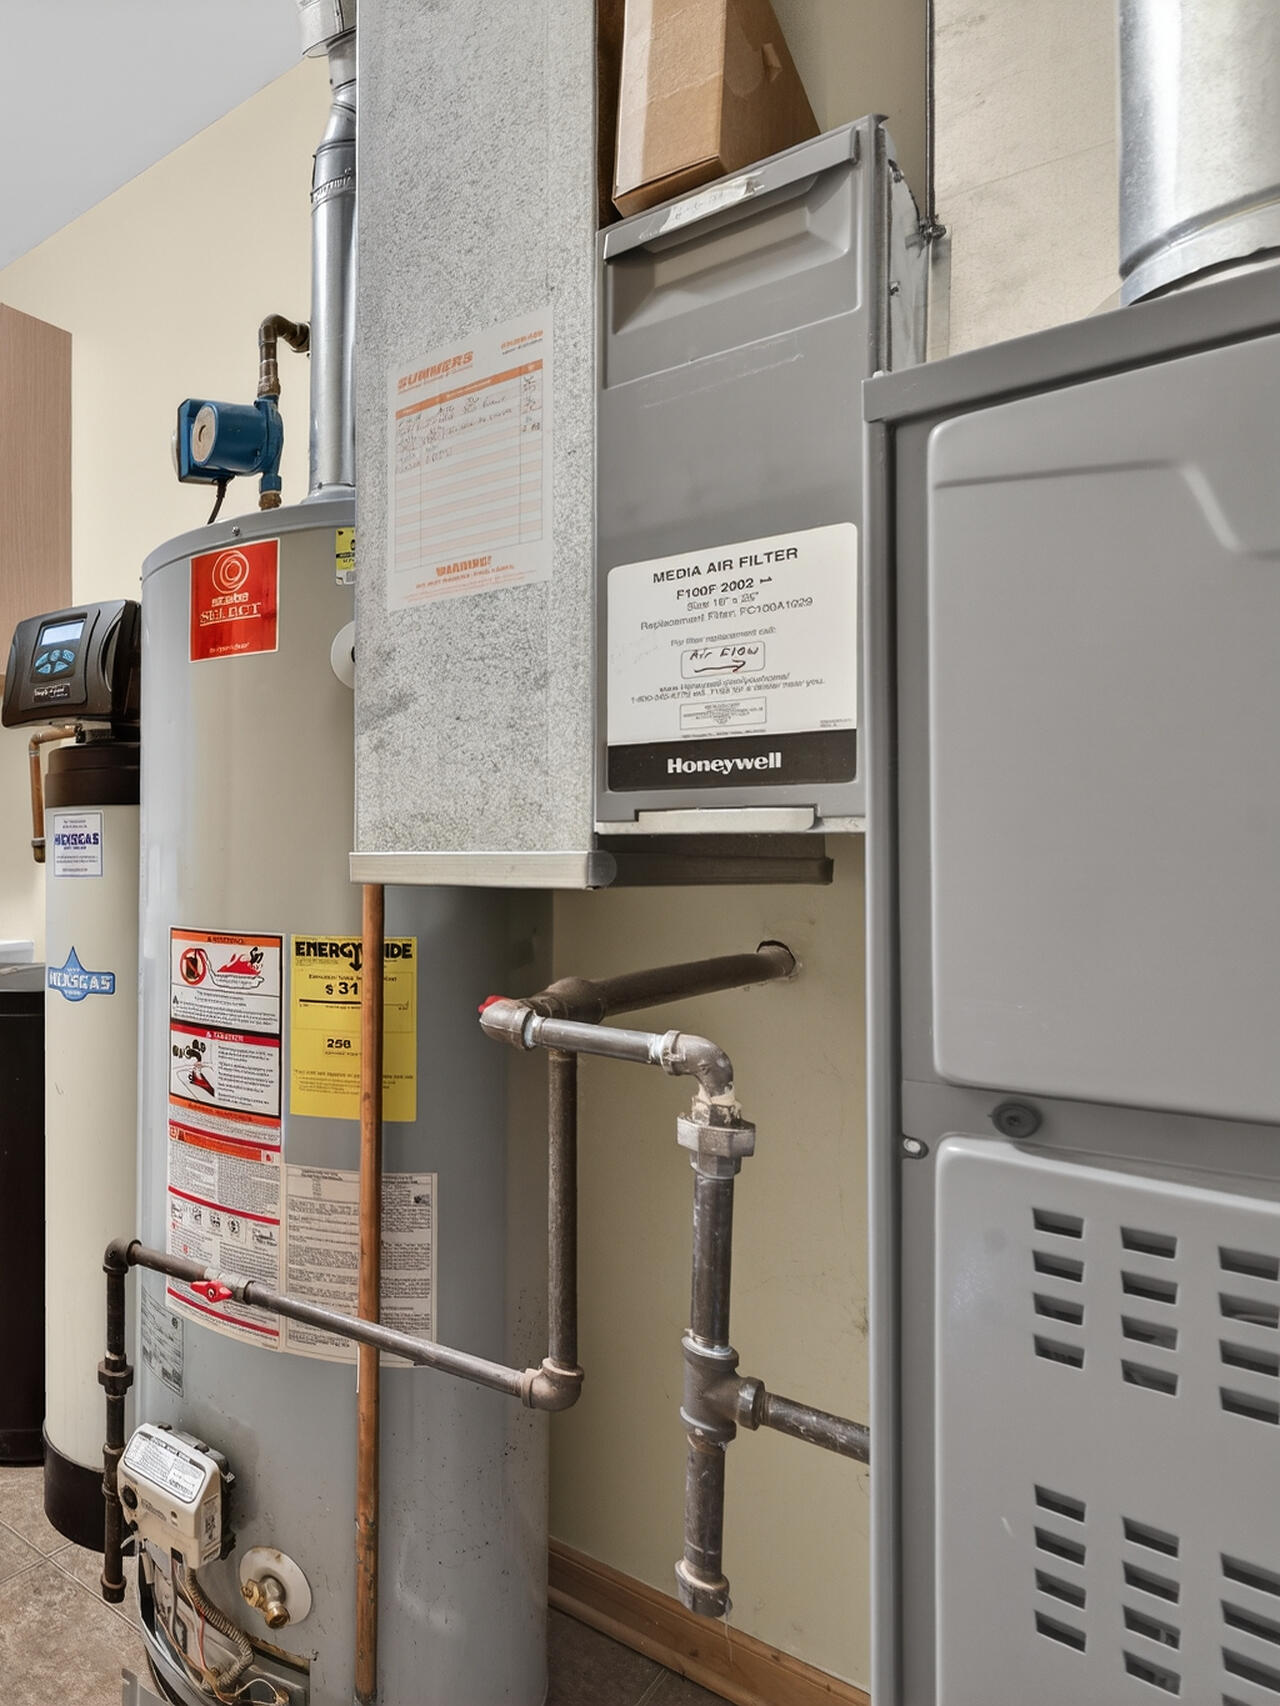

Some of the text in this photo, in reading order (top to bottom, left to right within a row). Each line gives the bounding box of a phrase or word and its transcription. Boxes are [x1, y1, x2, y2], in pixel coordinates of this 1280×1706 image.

[398, 350, 473, 391] SUMMERS
[653, 547, 799, 584] MEDIA AIR FILTER
[676, 578, 754, 600] F100F 2002
[199, 602, 262, 624] SELECT
[667, 752, 783, 775] Honeywell
[295, 941, 413, 959] ENERGYIDE
